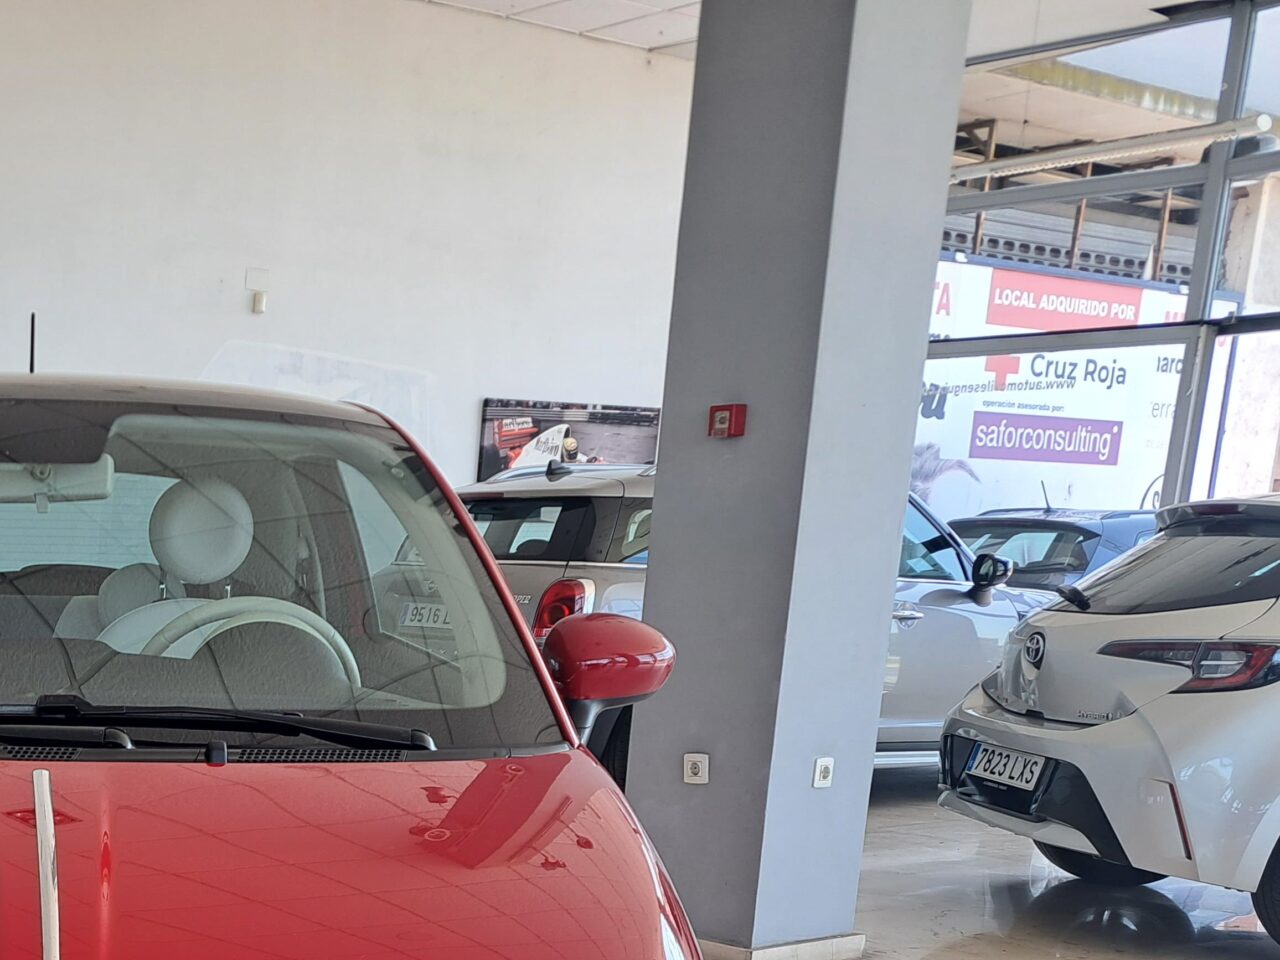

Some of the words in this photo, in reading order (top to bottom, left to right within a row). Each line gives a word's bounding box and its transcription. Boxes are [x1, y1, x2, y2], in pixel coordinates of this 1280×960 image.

[993, 287, 1037, 309] LOCAL
[1038, 294, 1109, 317] ADQUIRIDO
[1109, 303, 1137, 321] POR
[1030, 353, 1079, 381] Cruz
[1083, 358, 1127, 390] Roja
[975, 420, 1112, 461] saforconsulting
[409, 606, 441, 624] 9516
[974, 747, 1011, 777] 7823
[1007, 755, 1039, 784] LXS
